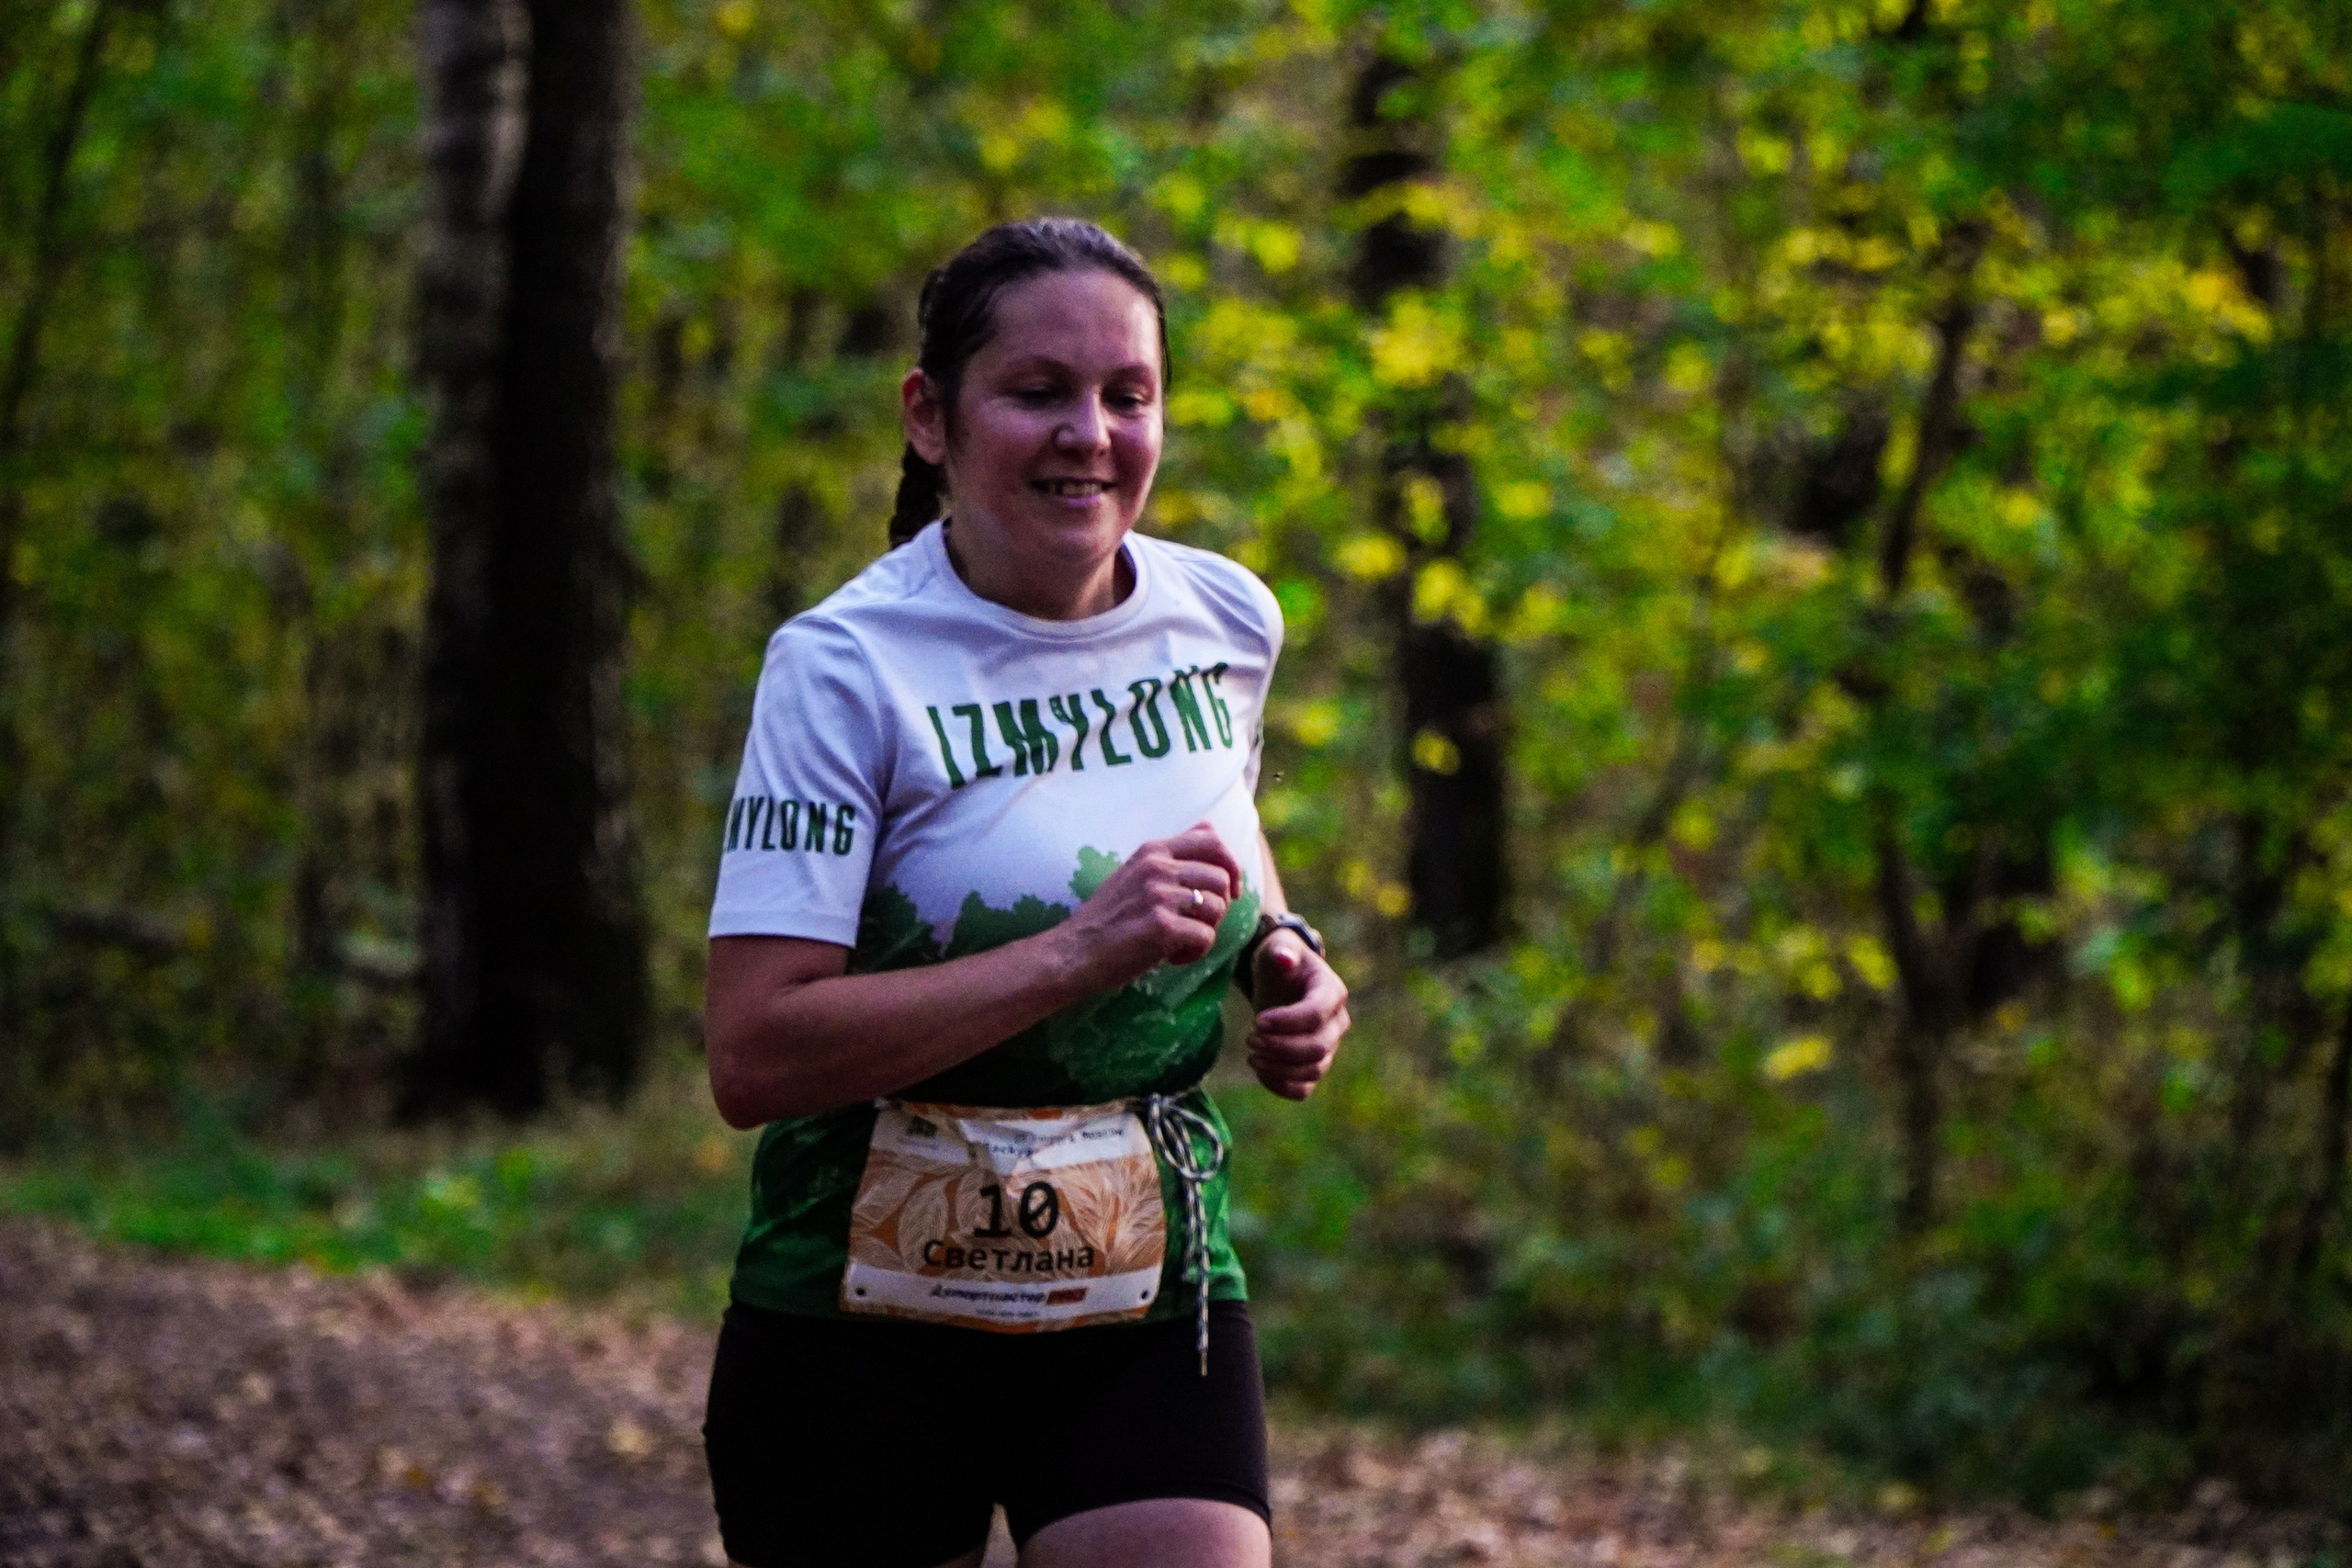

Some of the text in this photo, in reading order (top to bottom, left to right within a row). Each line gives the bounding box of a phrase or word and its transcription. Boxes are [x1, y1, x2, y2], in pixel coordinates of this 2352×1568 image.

[926, 662, 1234, 790] IZMYLONG
[975, 1181, 1058, 1237] 10
[924, 1240, 1094, 1272] Светлана
